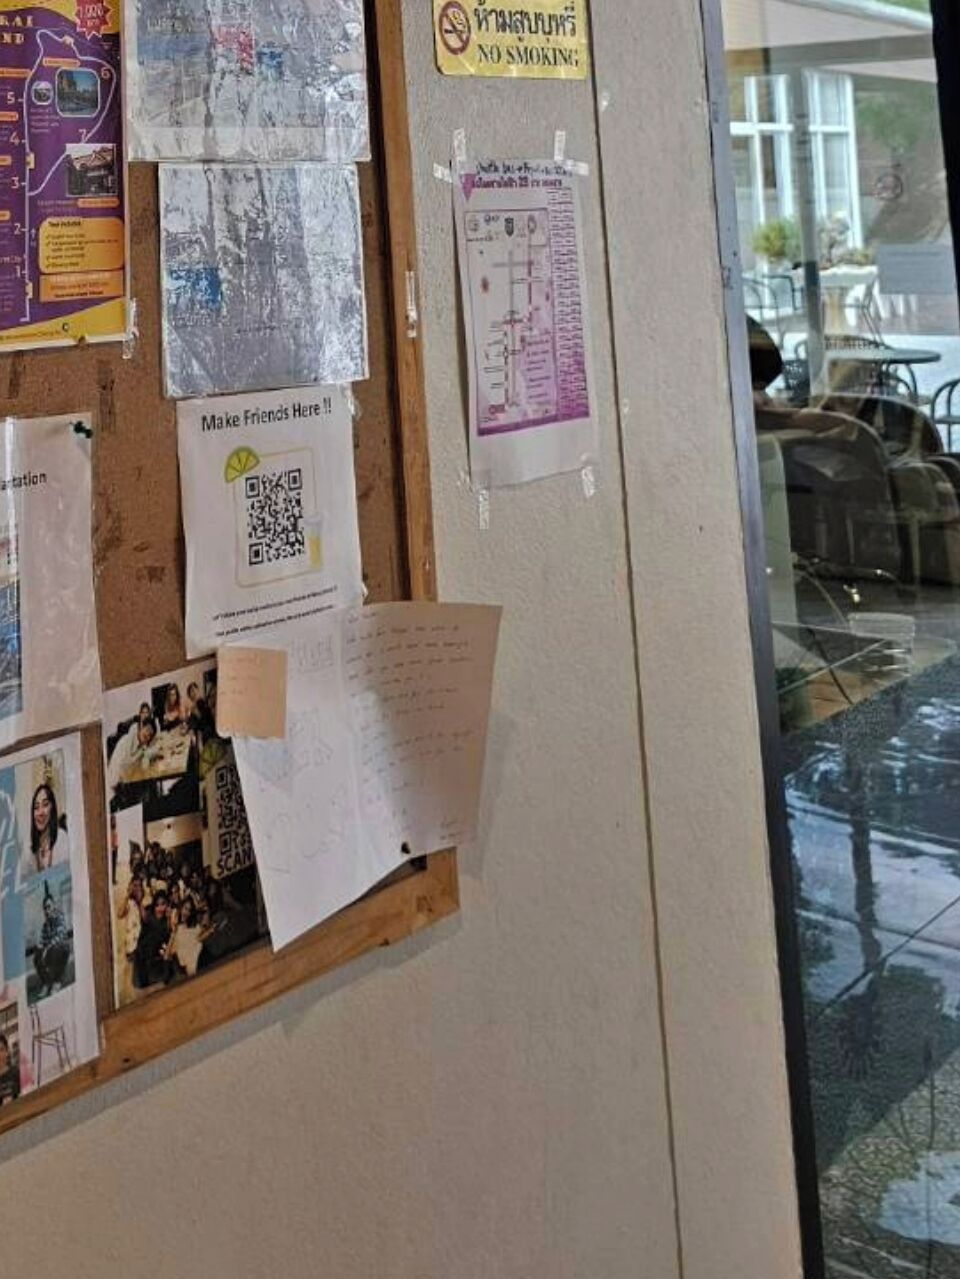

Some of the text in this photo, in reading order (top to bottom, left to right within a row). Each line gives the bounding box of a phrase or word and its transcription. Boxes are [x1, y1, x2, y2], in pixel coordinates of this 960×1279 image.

[477, 44, 579, 67] NO SMOKING
[101, 67, 110, 79] 6
[6, 91, 15, 104] 5
[8, 132, 19, 145] 4
[11, 176, 20, 189] 3
[14, 224, 21, 236] 2
[201, 413, 240, 432] Make
[244, 407, 290, 427] Friends
[292, 403, 321, 418] Here
[216, 848, 254, 874] SCAN
